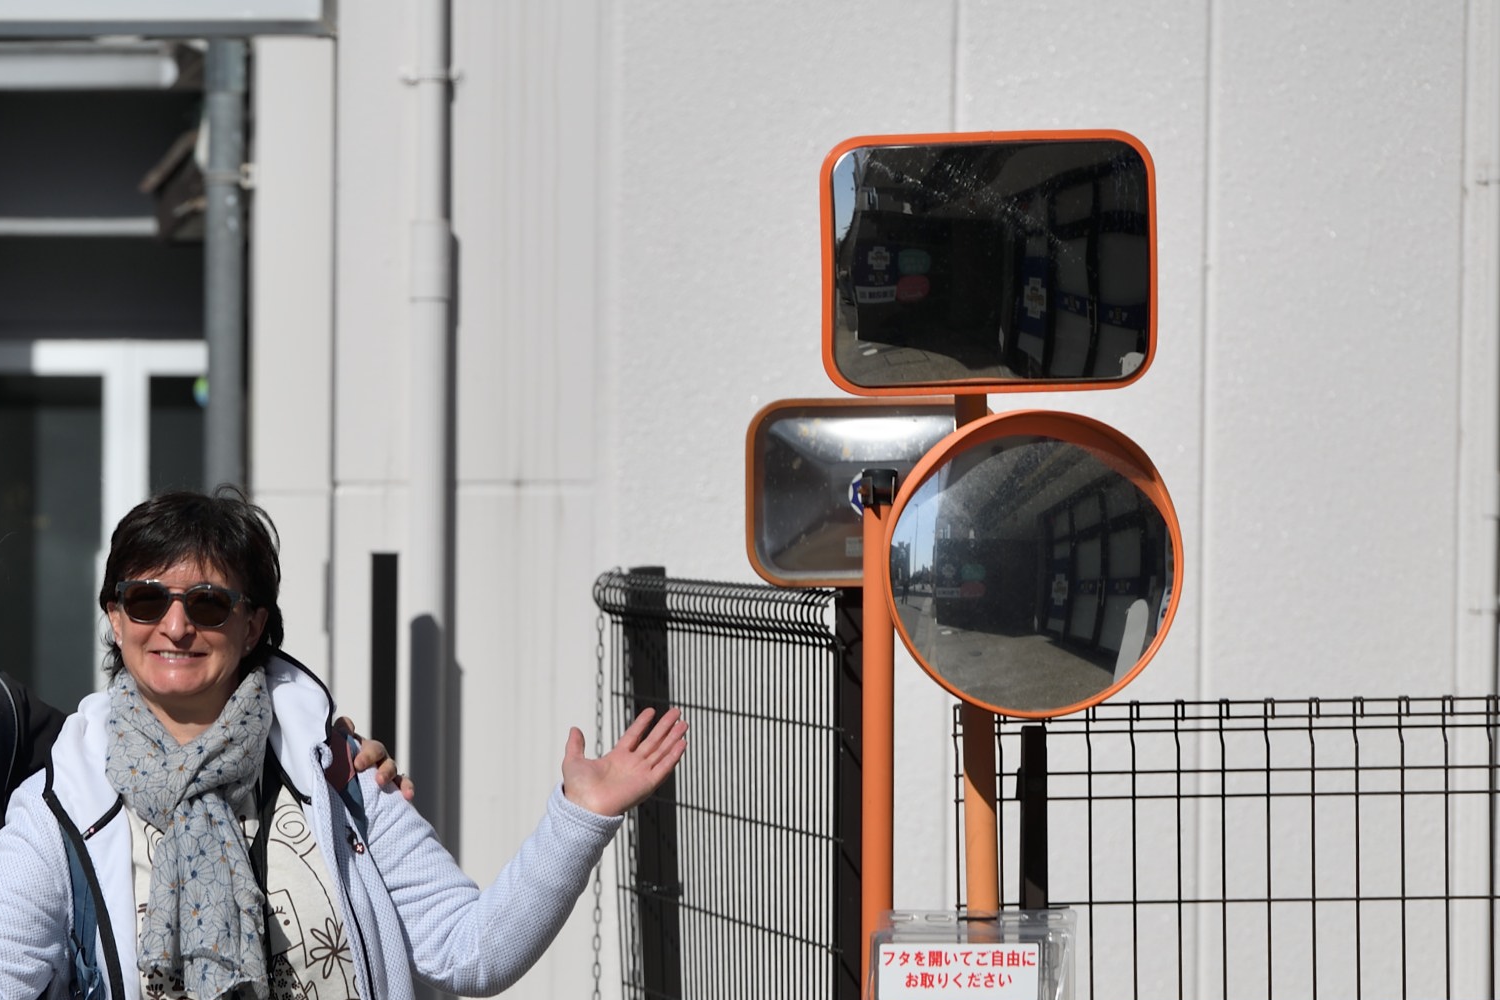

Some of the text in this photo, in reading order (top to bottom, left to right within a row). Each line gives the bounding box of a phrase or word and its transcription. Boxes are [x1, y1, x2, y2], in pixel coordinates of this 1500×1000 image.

[883, 950, 1036, 967] フタを開いてご自由に
[905, 972, 1012, 989] お取りください
